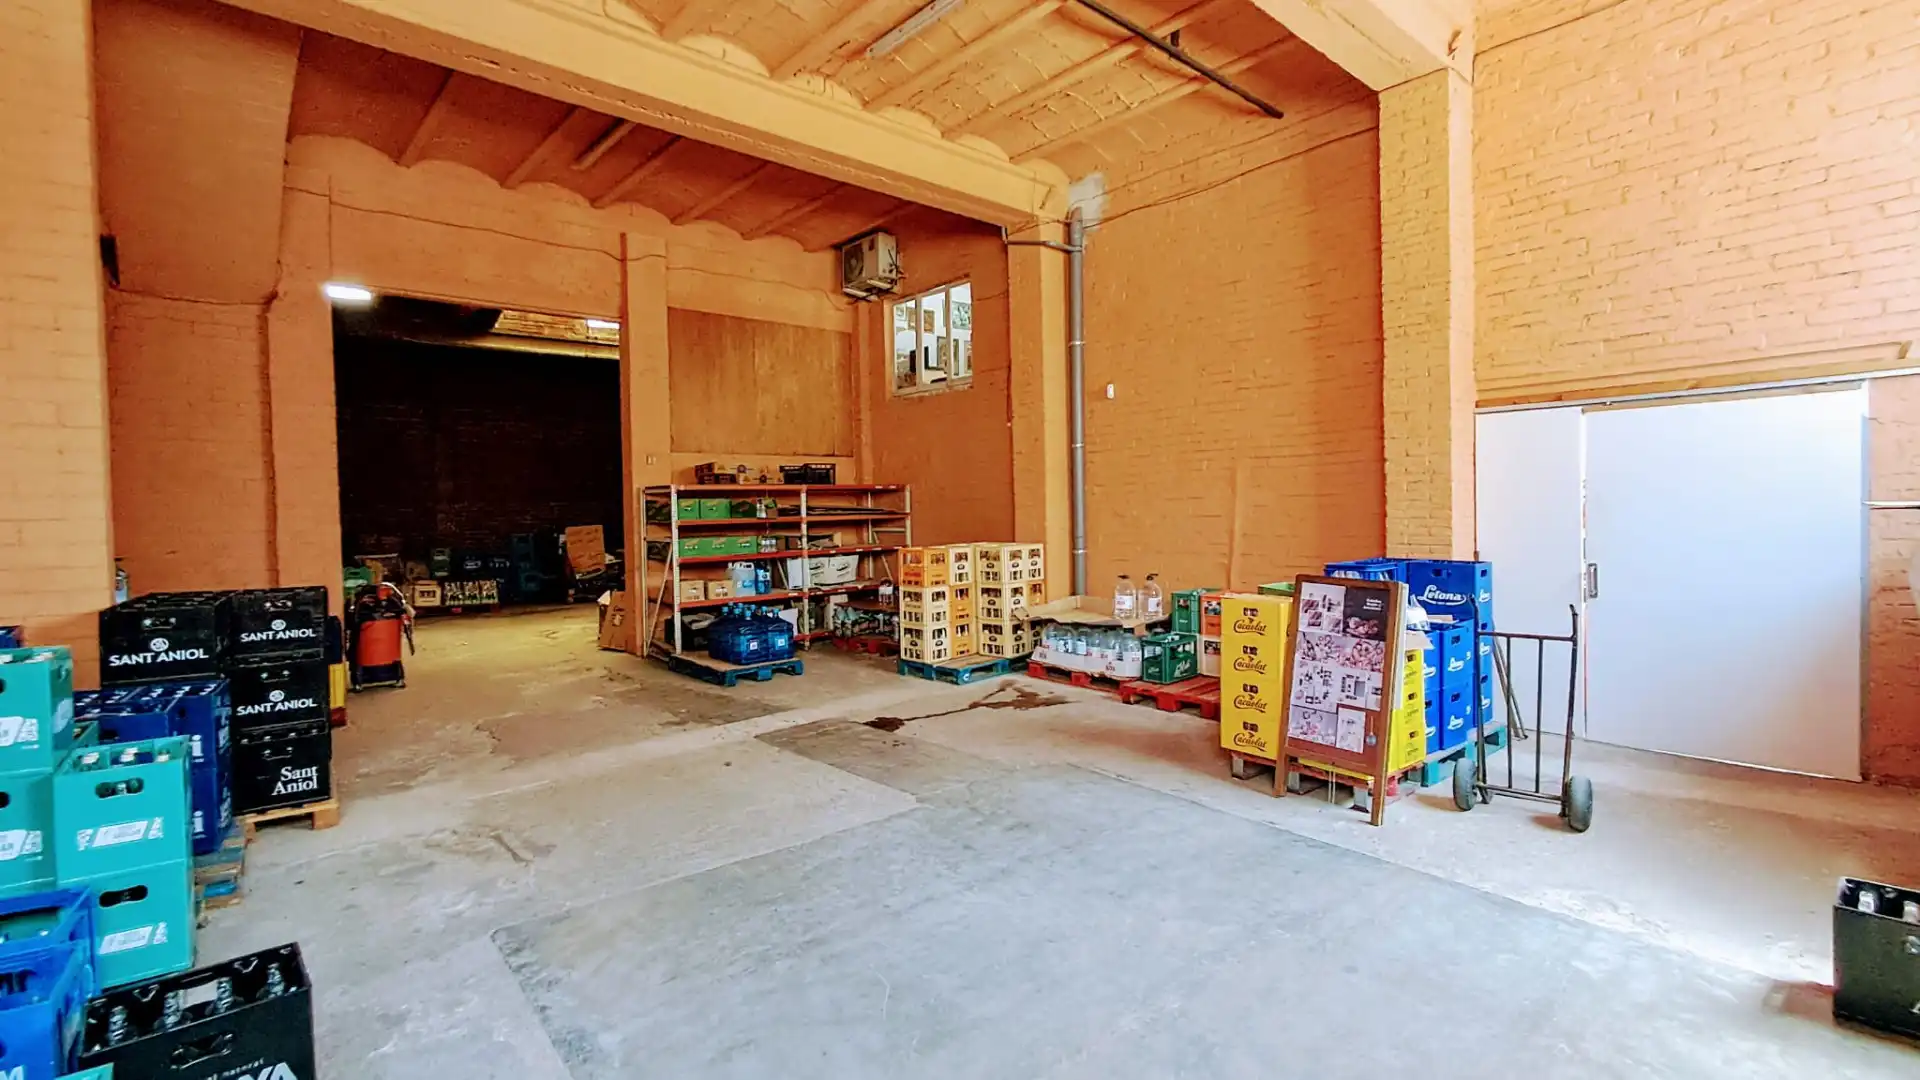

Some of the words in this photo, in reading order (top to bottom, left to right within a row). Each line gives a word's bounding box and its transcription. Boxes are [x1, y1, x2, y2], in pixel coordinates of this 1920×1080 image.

[1417, 585, 1466, 605] Letona
[240, 631, 275, 642] SANT
[275, 628, 317, 640] ANIOL
[1233, 619, 1267, 635] Cacaolat
[108, 652, 155, 666] SANT
[156, 648, 209, 662] ANIOL
[1233, 657, 1267, 674] Cacaolat
[236, 704, 272, 716] SANT
[274, 698, 318, 711] ANIOL
[1233, 695, 1267, 713] Cacaolat
[281, 765, 318, 781] Sant
[271, 777, 318, 796] Aniol
